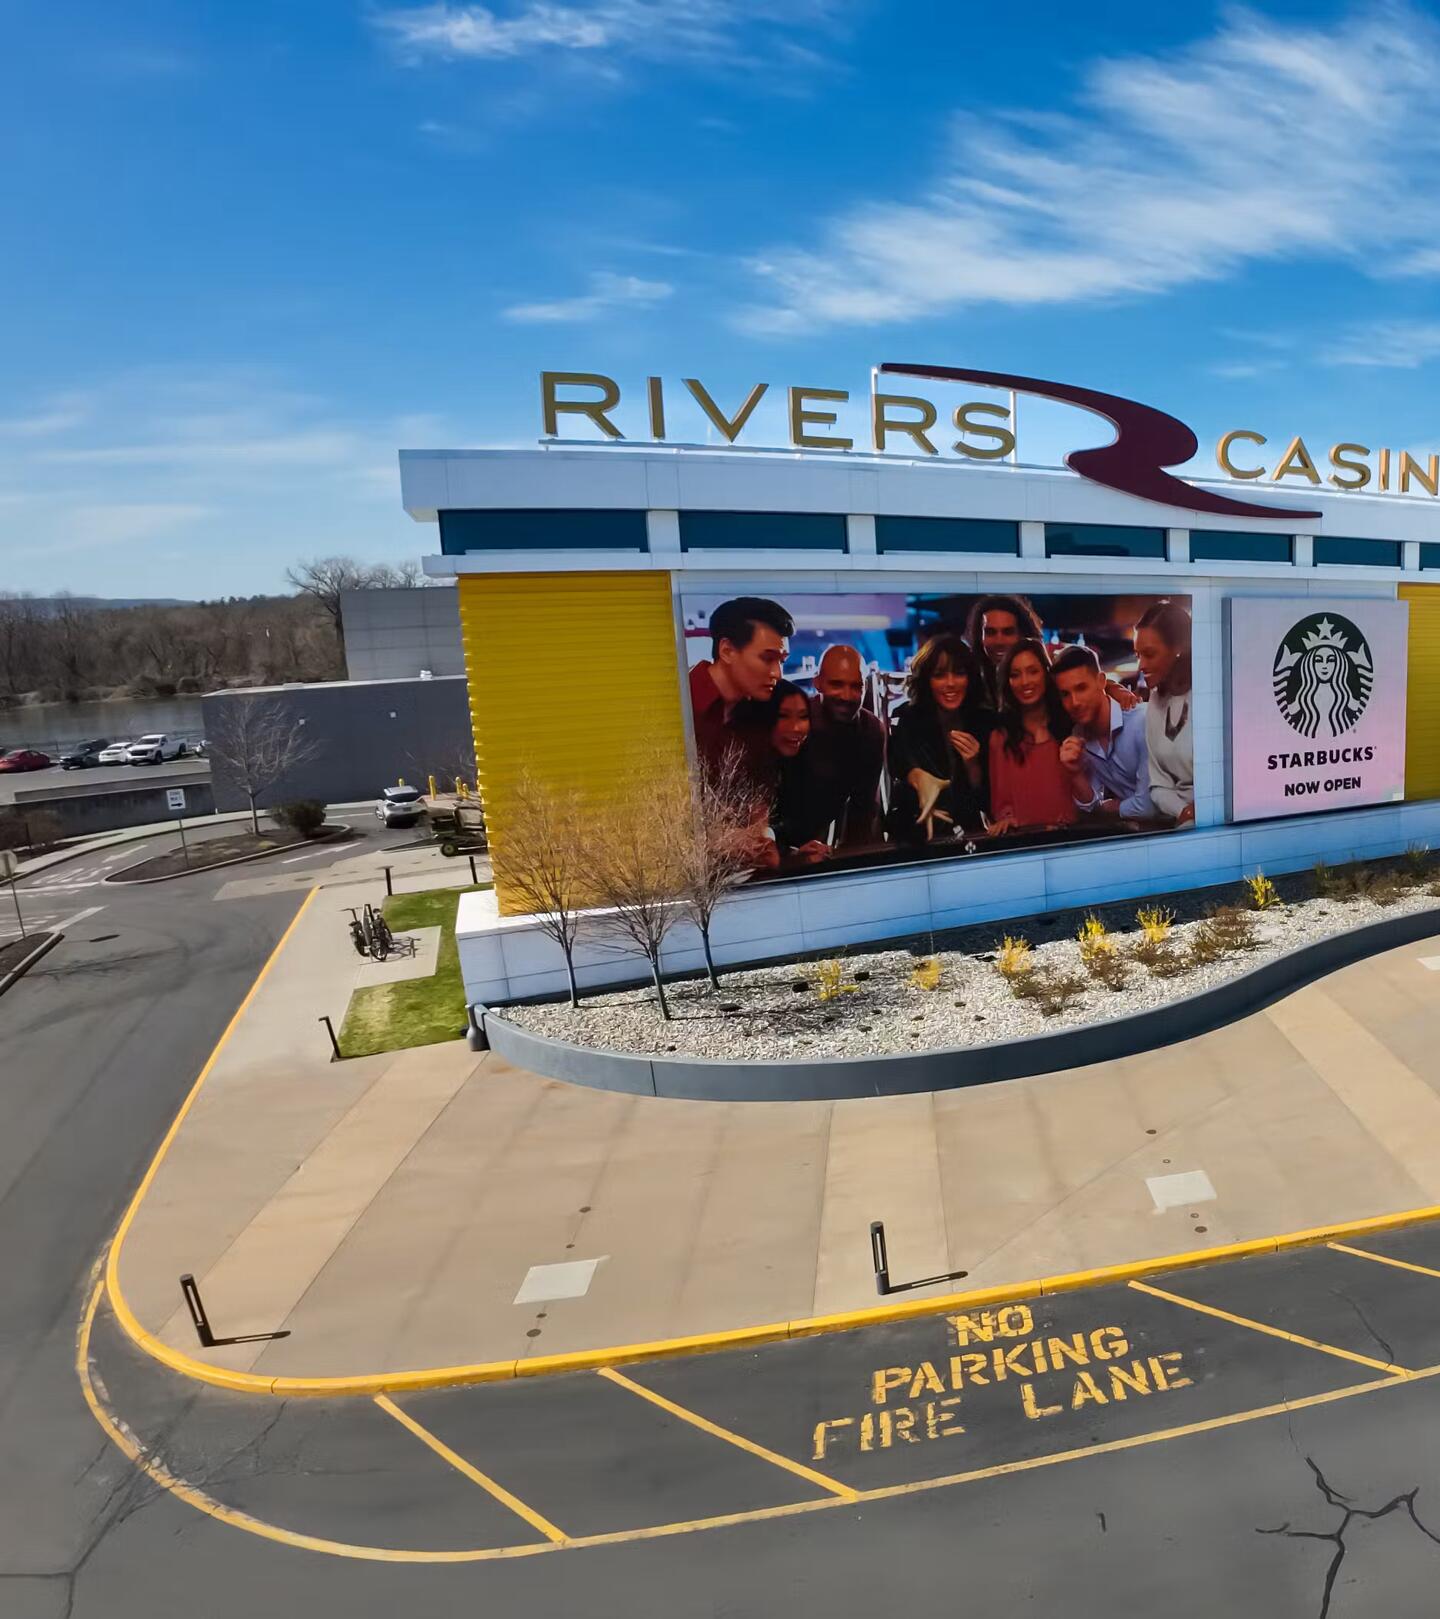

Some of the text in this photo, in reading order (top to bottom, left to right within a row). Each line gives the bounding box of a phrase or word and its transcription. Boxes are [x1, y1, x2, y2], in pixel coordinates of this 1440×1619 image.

[539, 371, 1016, 460] RIVERS
[1267, 746, 1375, 770] STARBUCKS
[1284, 776, 1362, 797] NOW OPEN
[947, 1304, 1034, 1346] NO
[872, 1326, 1129, 1404] PARKING
[812, 1352, 1194, 1460] FIRE LANE
